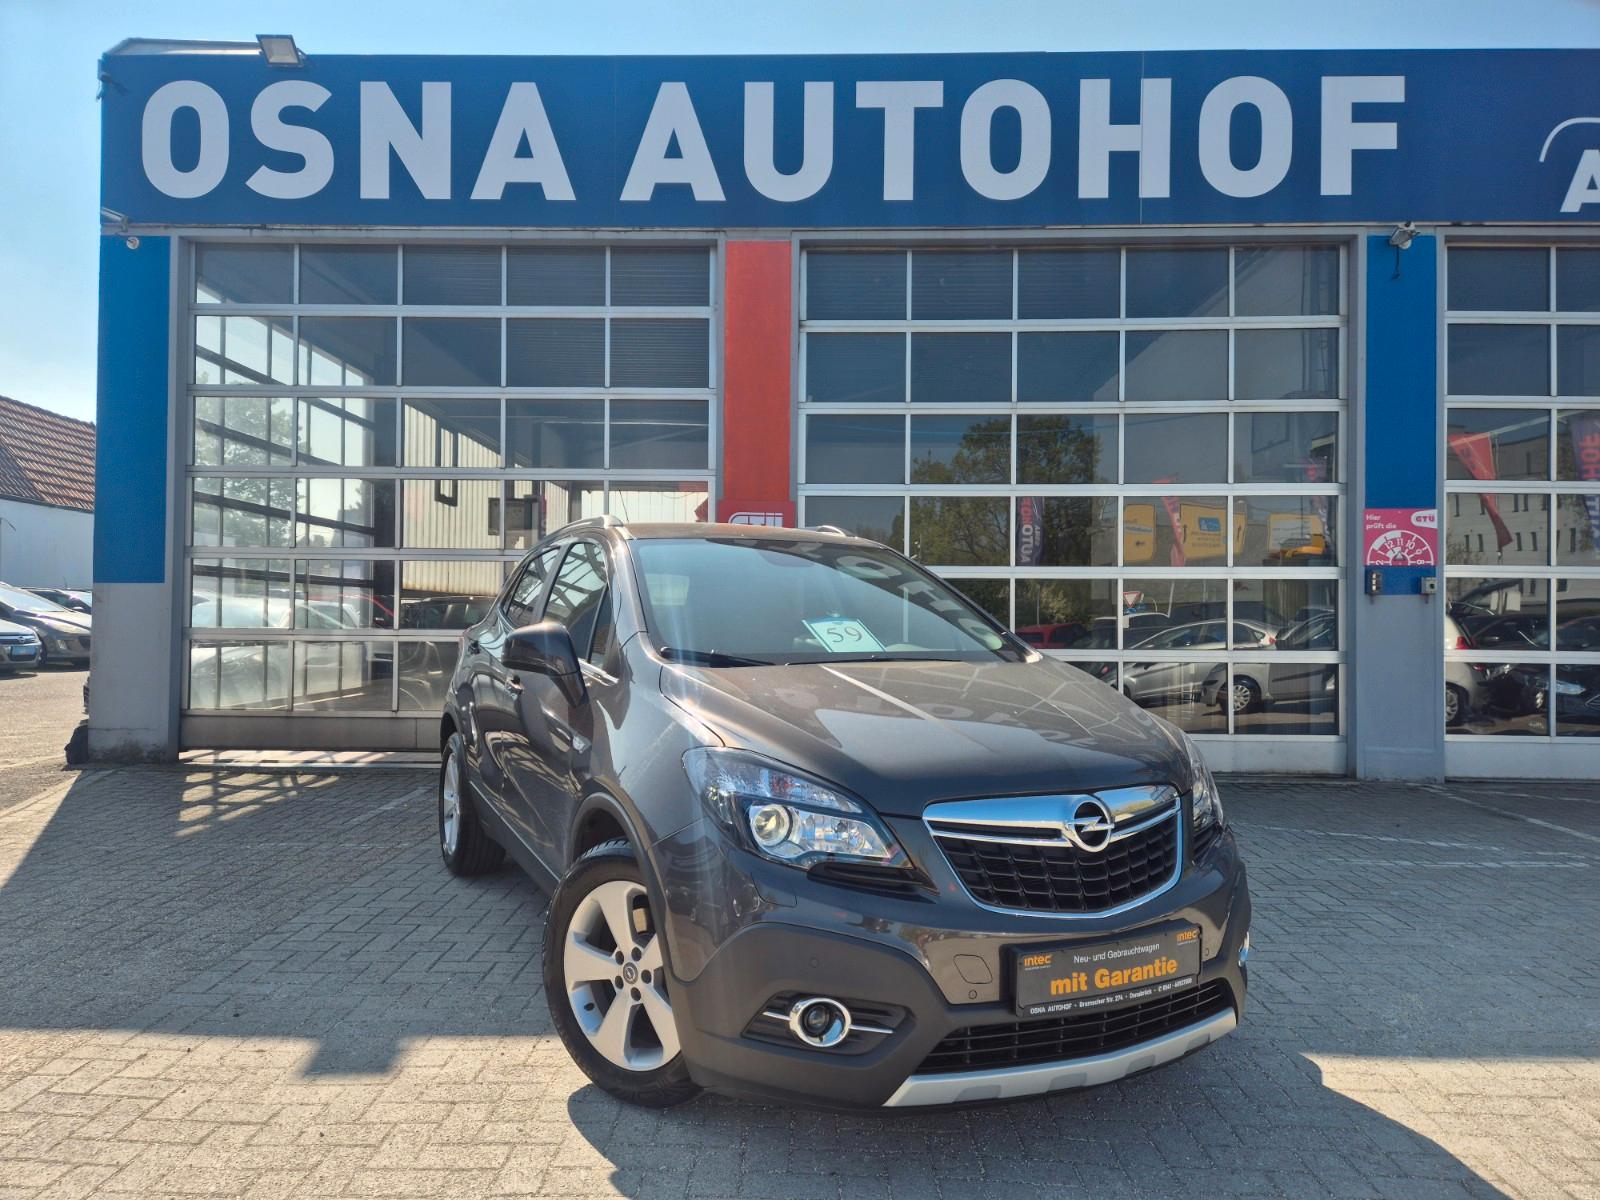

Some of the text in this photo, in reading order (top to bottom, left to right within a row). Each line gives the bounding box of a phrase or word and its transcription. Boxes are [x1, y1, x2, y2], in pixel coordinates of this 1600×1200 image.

[143, 76, 1404, 201] OSNA AUTOHOF
[1366, 522, 1384, 530] prüft
[1397, 538, 1404, 546] 11
[1406, 540, 1416, 550] 10
[827, 625, 862, 643] 59
[1176, 929, 1199, 942] intec
[1023, 954, 1052, 966] intec
[1073, 943, 1160, 964] Neu- und Gebrauchtwagen
[1050, 971, 1088, 995] mit
[1094, 957, 1178, 989] Garantie
[1030, 1006, 1046, 1015] OSNA
[1048, 1002, 1073, 1013] AUTOHOF
